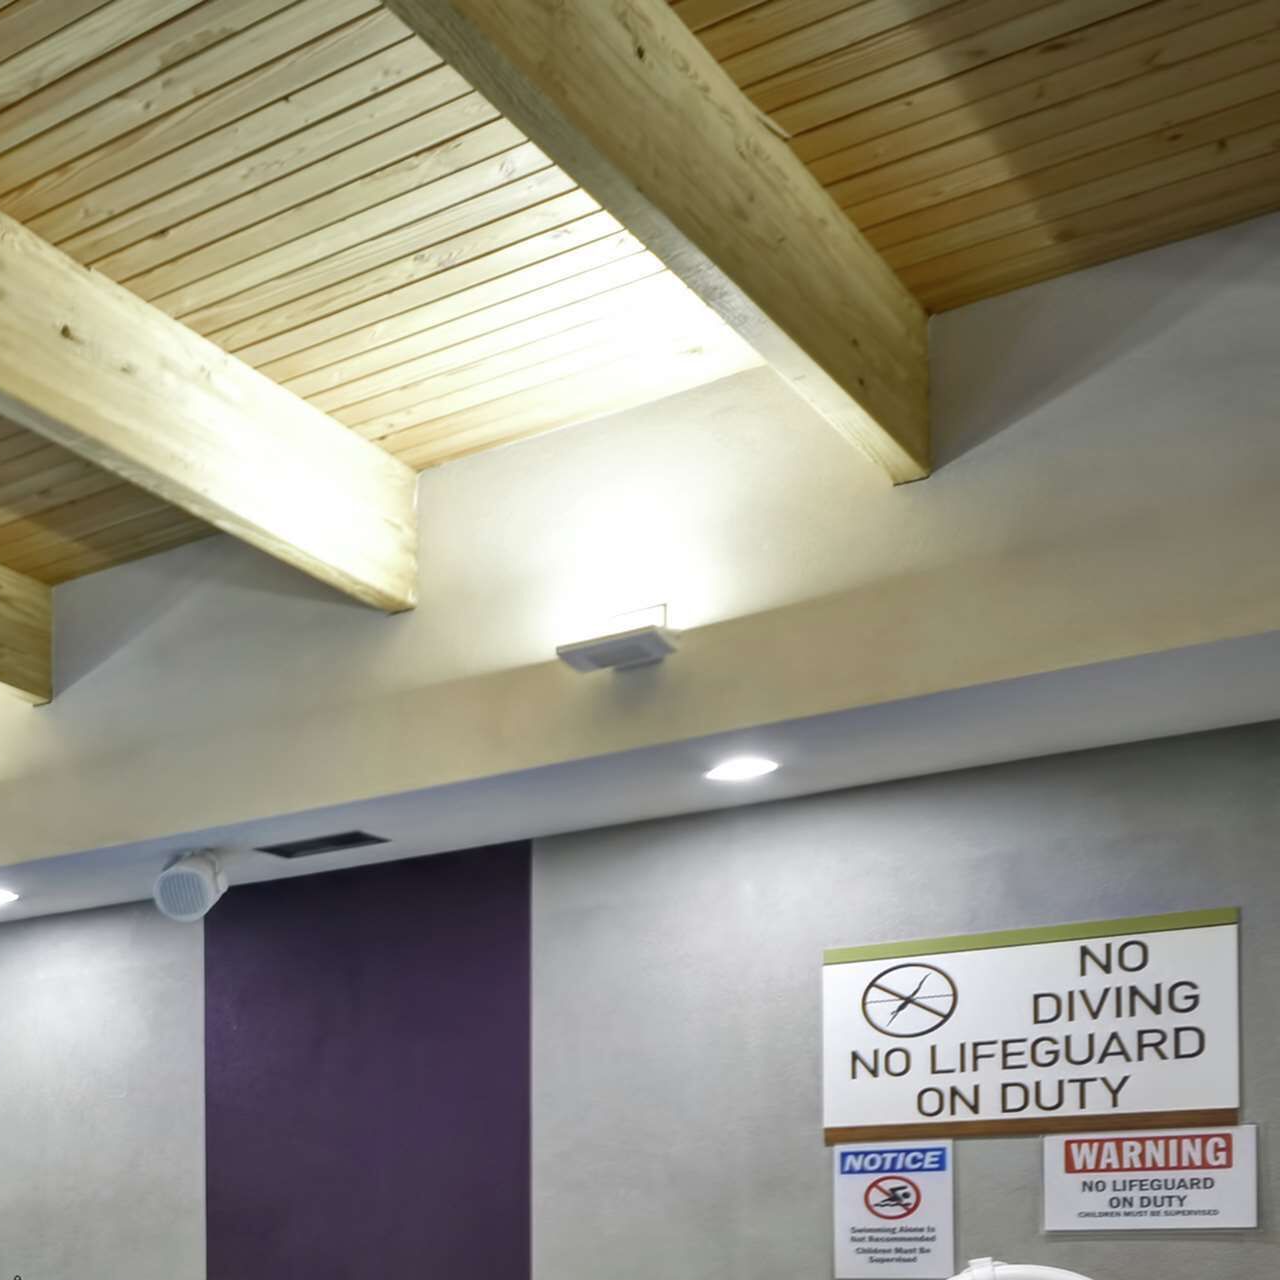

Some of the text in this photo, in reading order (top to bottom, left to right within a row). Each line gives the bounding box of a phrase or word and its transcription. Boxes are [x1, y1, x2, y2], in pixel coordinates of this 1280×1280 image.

[1080, 940, 1149, 977] NO
[1032, 981, 1201, 1025] DIVING
[850, 1026, 1206, 1080] NO LIFEGUARD
[916, 1075, 1131, 1117] ON DUTY
[843, 1151, 943, 1172] NOTICE
[1070, 1136, 1228, 1170] WARNING
[1082, 1177, 1215, 1192] NO LIFEGUARD
[1109, 1195, 1188, 1209] ON DUTY
[1163, 1209, 1220, 1217] SUPERVISED
